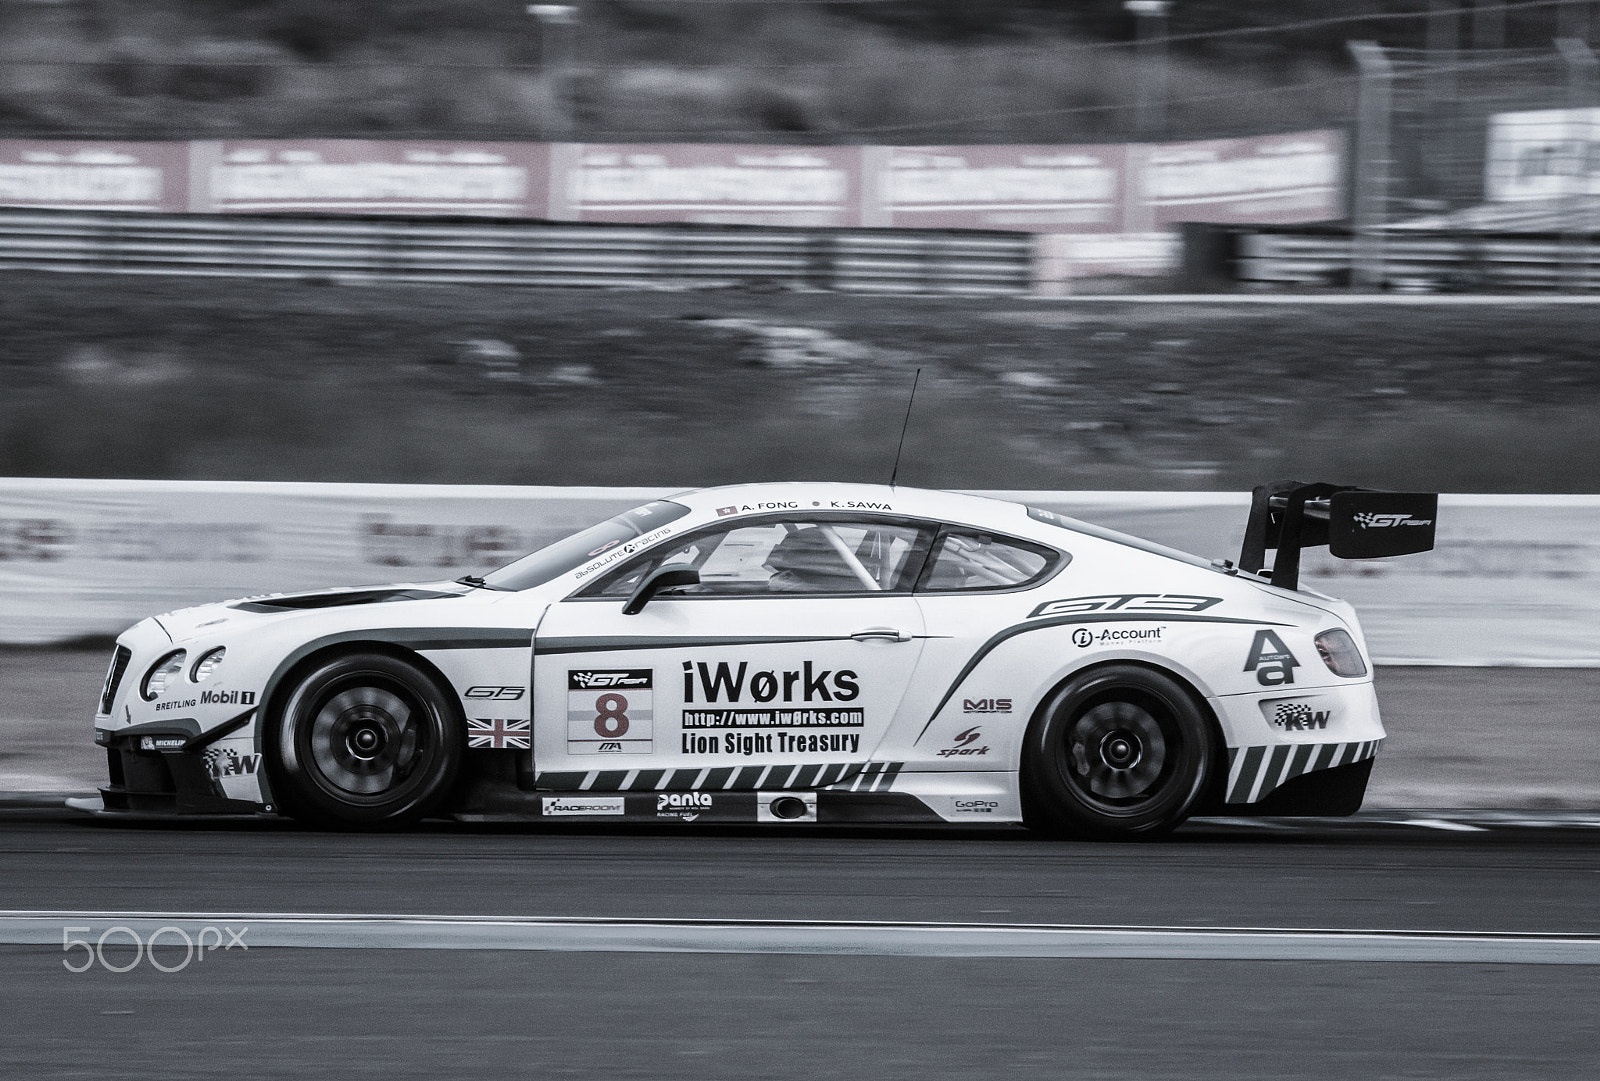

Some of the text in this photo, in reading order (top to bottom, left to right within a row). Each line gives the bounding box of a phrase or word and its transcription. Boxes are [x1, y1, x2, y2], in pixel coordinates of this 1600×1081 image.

[757, 501, 798, 509] FONG
[155, 699, 196, 711] BREITLING
[200, 690, 238, 705] Mobil
[963, 699, 1012, 710] MIS
[594, 693, 630, 738] 8
[1285, 711, 1331, 731] KW
[682, 732, 860, 756] Lion Sight Treasury
[936, 746, 991, 758] spark
[656, 791, 713, 811] panta
